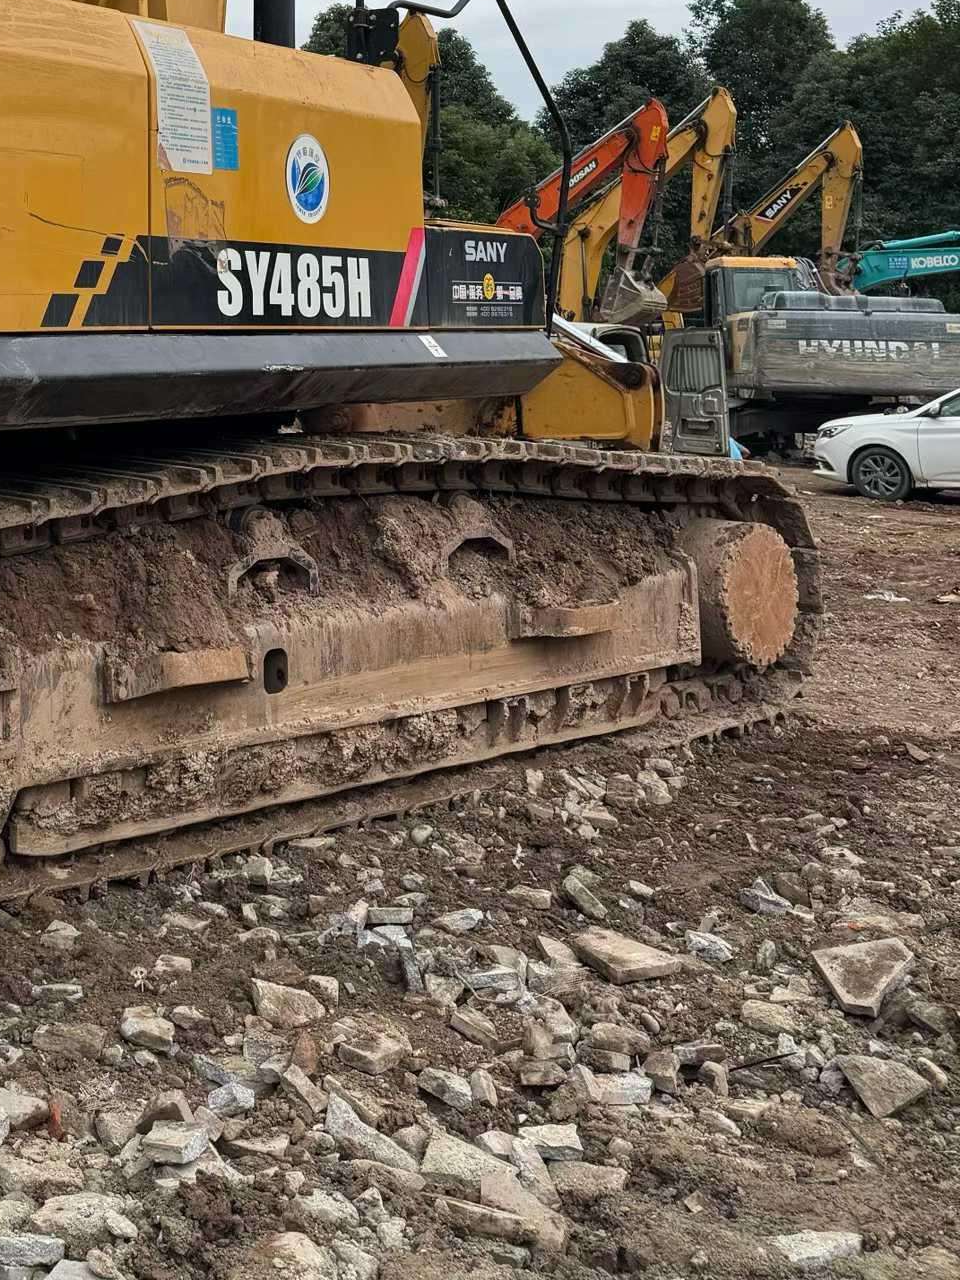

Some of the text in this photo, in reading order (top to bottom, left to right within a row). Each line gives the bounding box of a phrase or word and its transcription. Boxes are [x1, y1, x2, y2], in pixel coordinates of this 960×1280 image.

[568, 160, 597, 188] OOSAN
[765, 190, 792, 219] SANY
[464, 240, 508, 263] SANY
[911, 254, 959, 269] KOBELCO
[216, 247, 372, 318] SY485H
